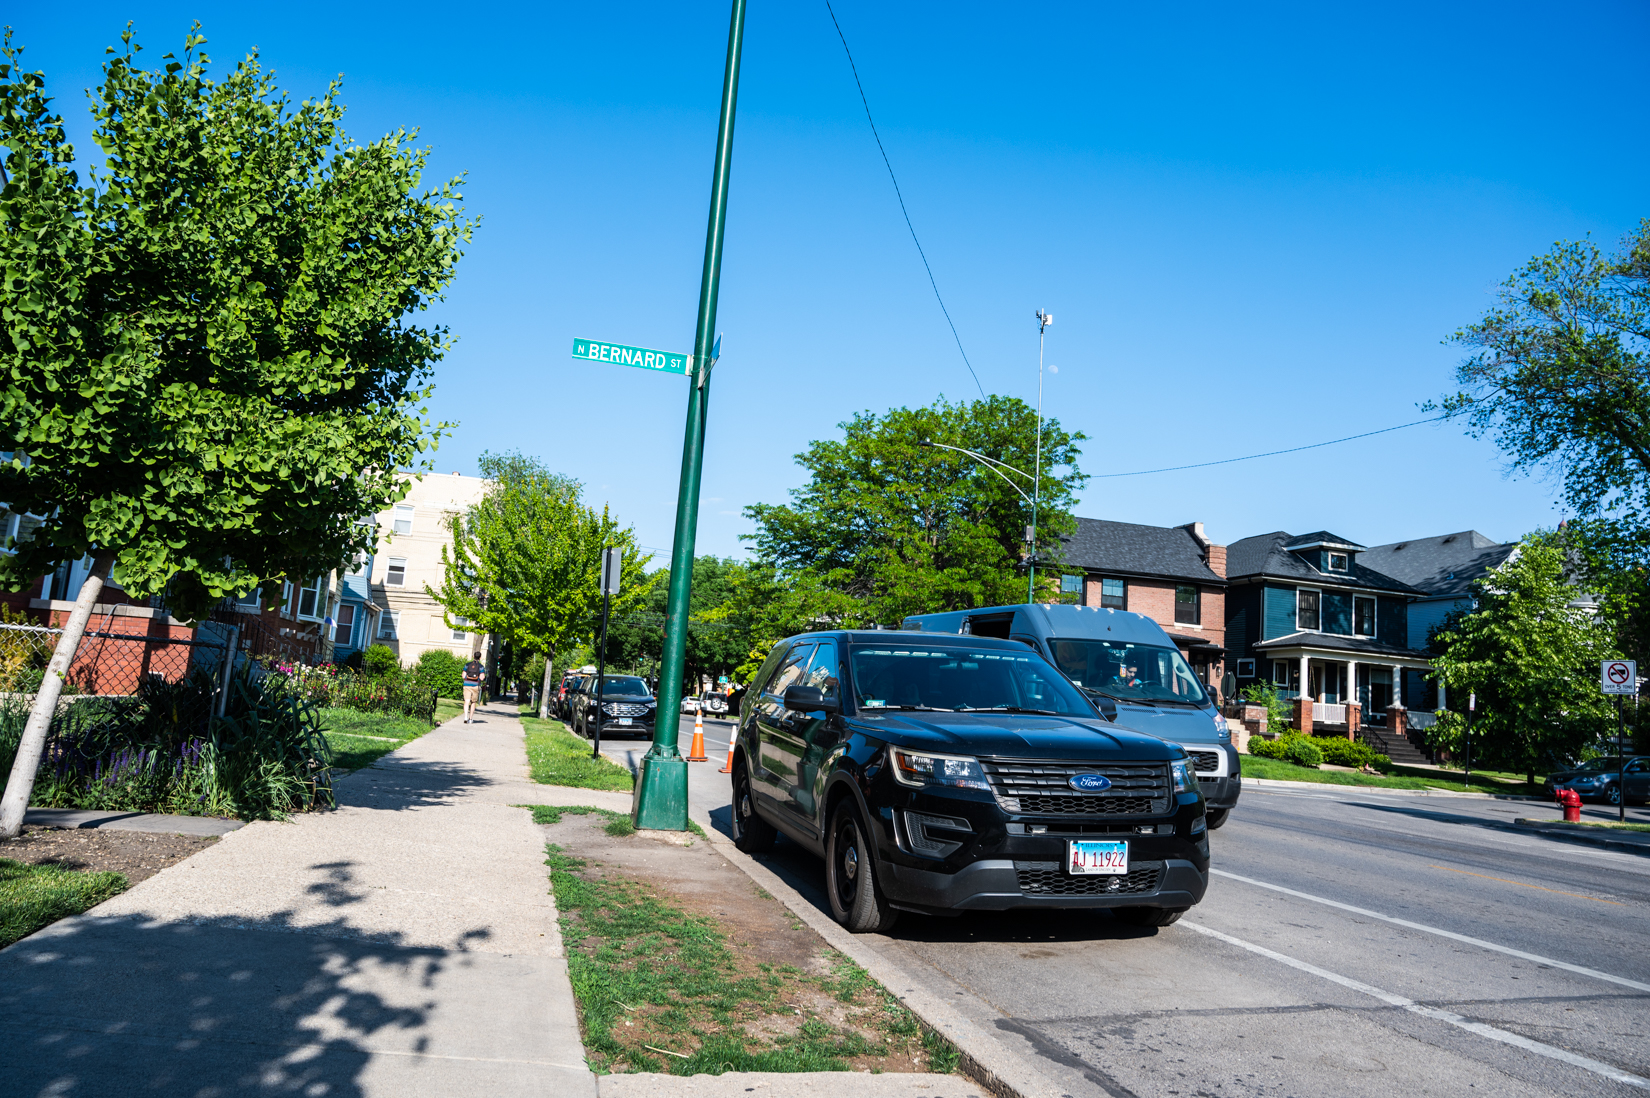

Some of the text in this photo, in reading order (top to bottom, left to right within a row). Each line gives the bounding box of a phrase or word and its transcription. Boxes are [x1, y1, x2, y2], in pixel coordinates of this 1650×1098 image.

[577, 343, 682, 369] N BERNARD ST
[1080, 776, 1103, 787] Ford
[1073, 851, 1125, 867] AJ 11922
